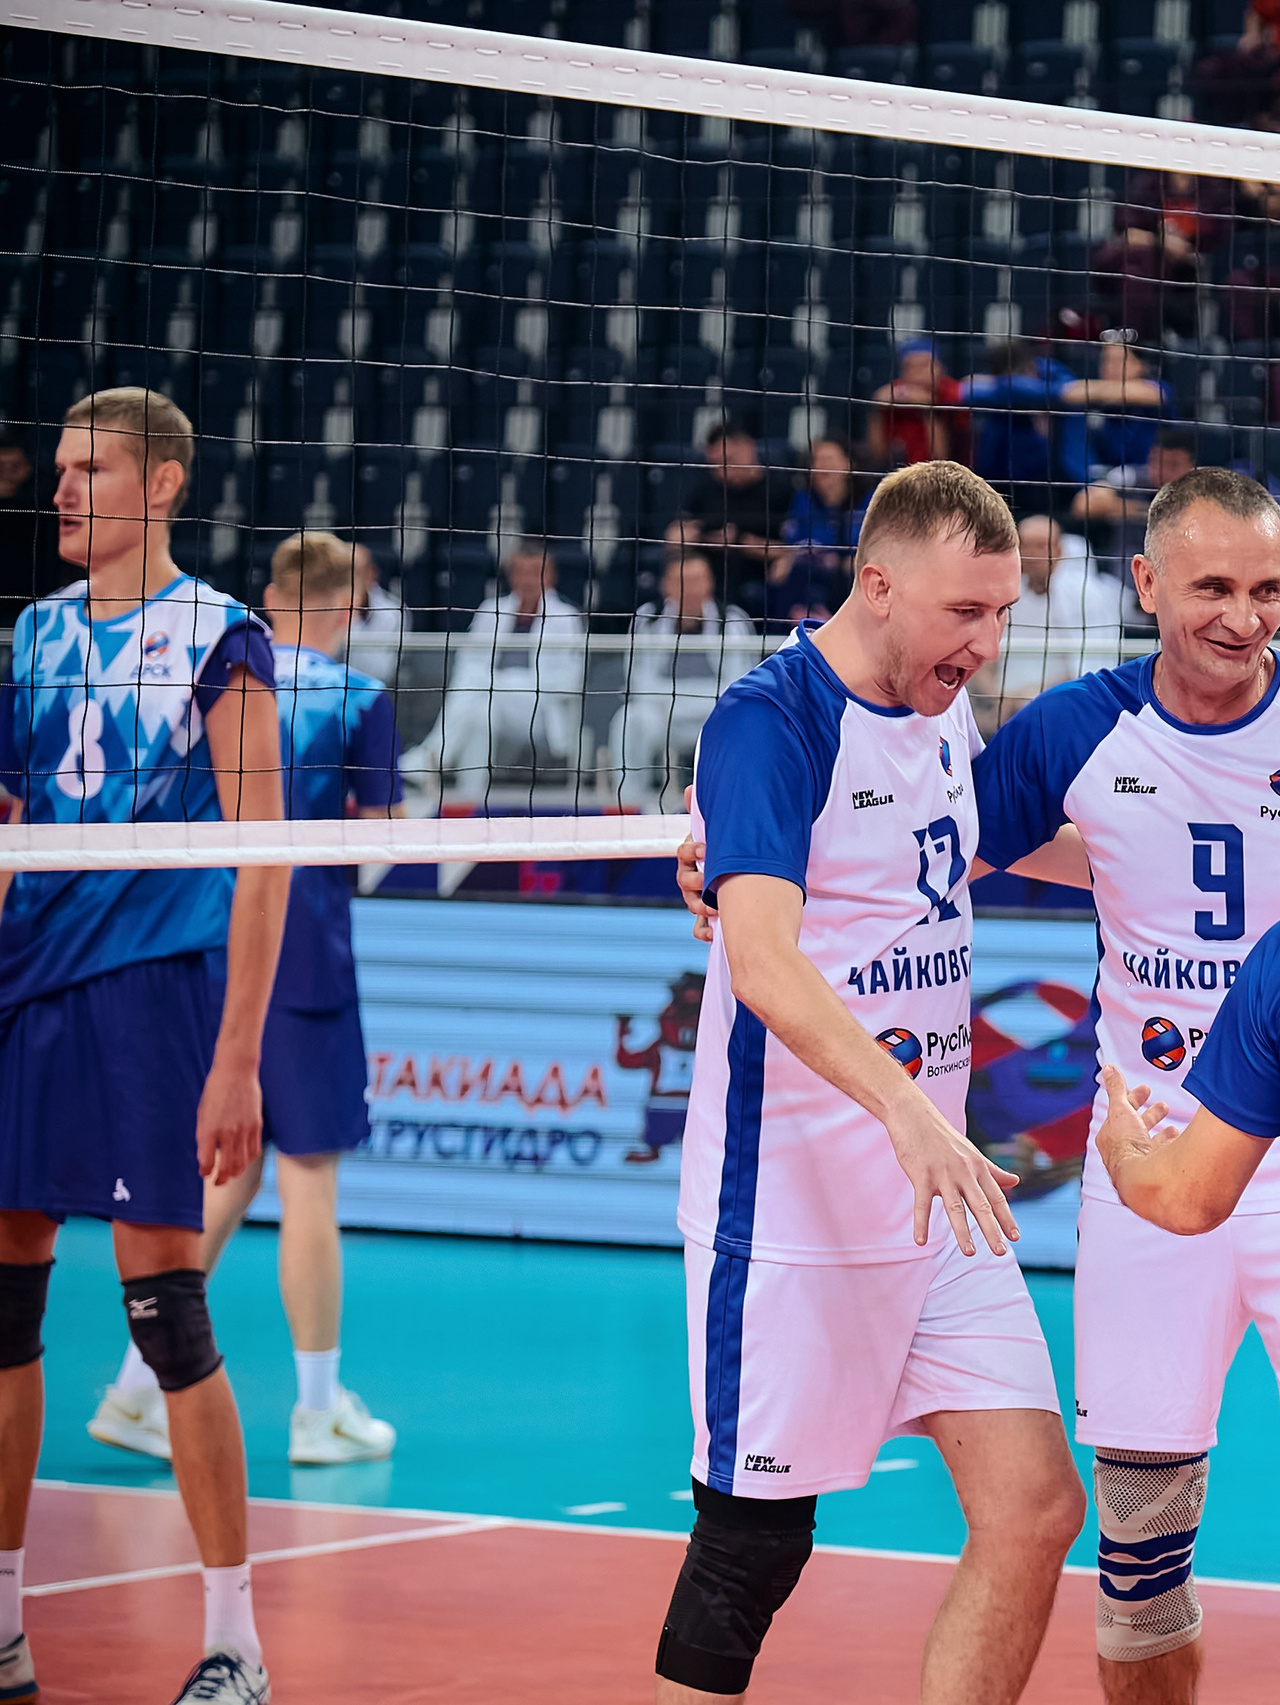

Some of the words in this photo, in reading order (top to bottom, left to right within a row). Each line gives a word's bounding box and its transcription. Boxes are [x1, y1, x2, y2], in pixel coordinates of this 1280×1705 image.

[56, 698, 106, 800] 8
[1113, 784, 1158, 794] LEAGUE
[1114, 776, 1140, 786] NEW
[852, 789, 875, 800] NEW
[852, 794, 895, 810] LEAGUE
[911, 815, 968, 926] 12
[1186, 822, 1246, 941] 9
[847, 944, 972, 996] ЧАЙКОВС
[927, 1023, 972, 1061] РусГи
[745, 1454, 776, 1465] NEW
[744, 1462, 792, 1474] LEAGUE
